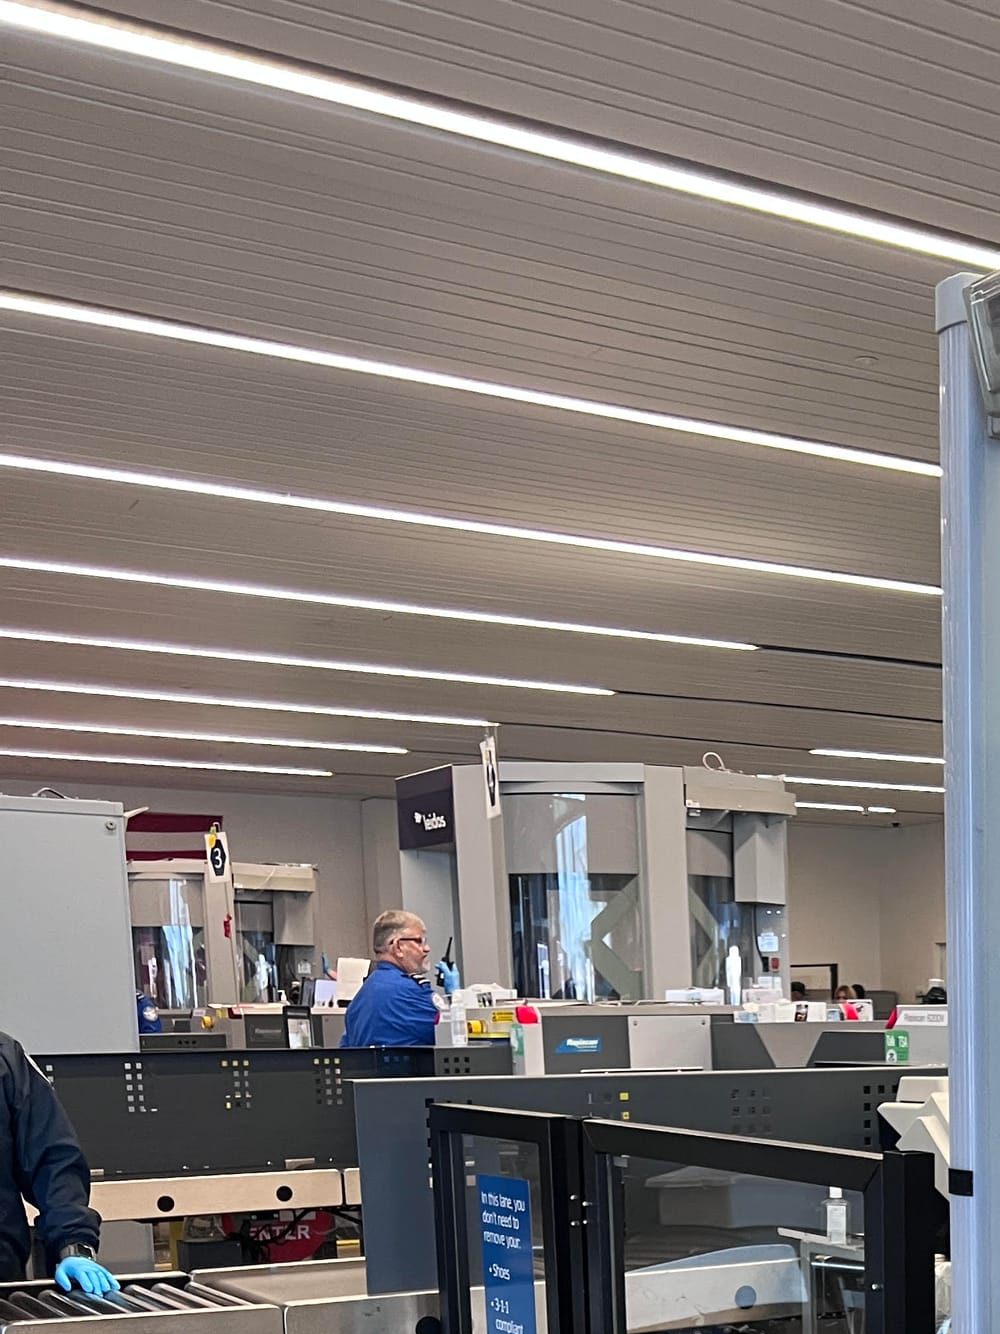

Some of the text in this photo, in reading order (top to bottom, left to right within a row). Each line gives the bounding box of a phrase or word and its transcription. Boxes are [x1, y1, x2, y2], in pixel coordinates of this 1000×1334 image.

[422, 812, 447, 831] leidos
[213, 847, 222, 869] 3
[481, 1191, 488, 1204] In
[488, 1192, 499, 1207] this
[513, 1199, 526, 1213] you
[482, 1209, 520, 1230] don't need to
[483, 1231, 506, 1246] remove
[492, 1263, 511, 1281] Shoes
[494, 1297, 510, 1314] 3-1-1
